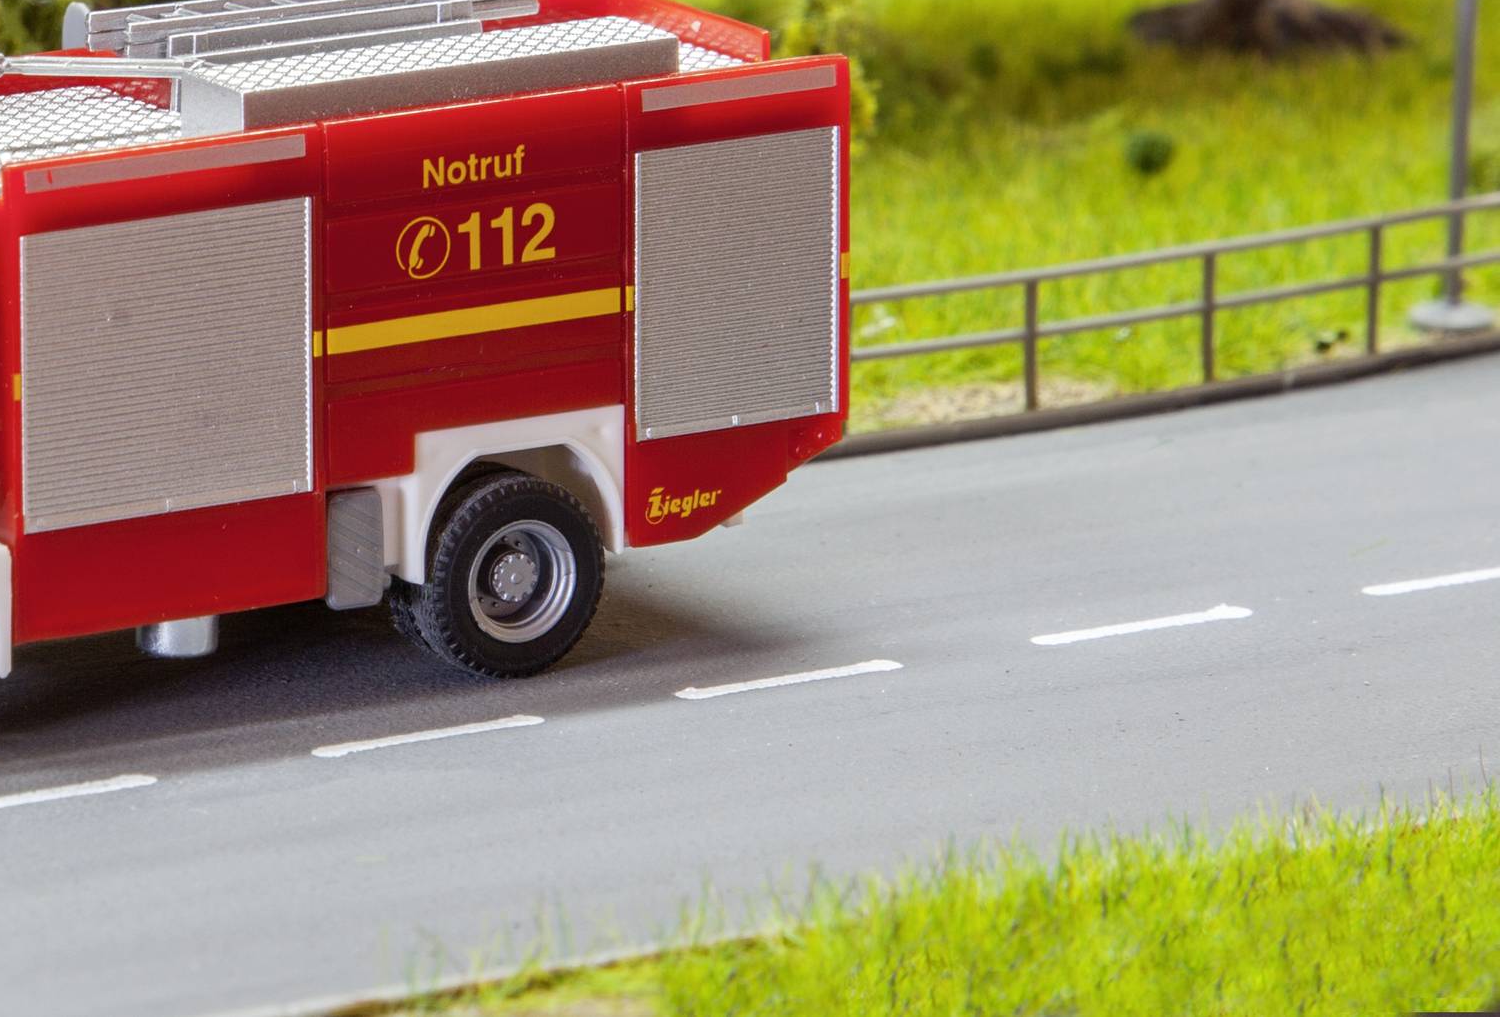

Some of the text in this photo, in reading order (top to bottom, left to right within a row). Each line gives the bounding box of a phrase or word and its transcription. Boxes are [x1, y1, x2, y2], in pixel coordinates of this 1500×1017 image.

[423, 144, 525, 189] Notruf
[457, 202, 556, 271] 112
[645, 487, 722, 524] Ziegler
